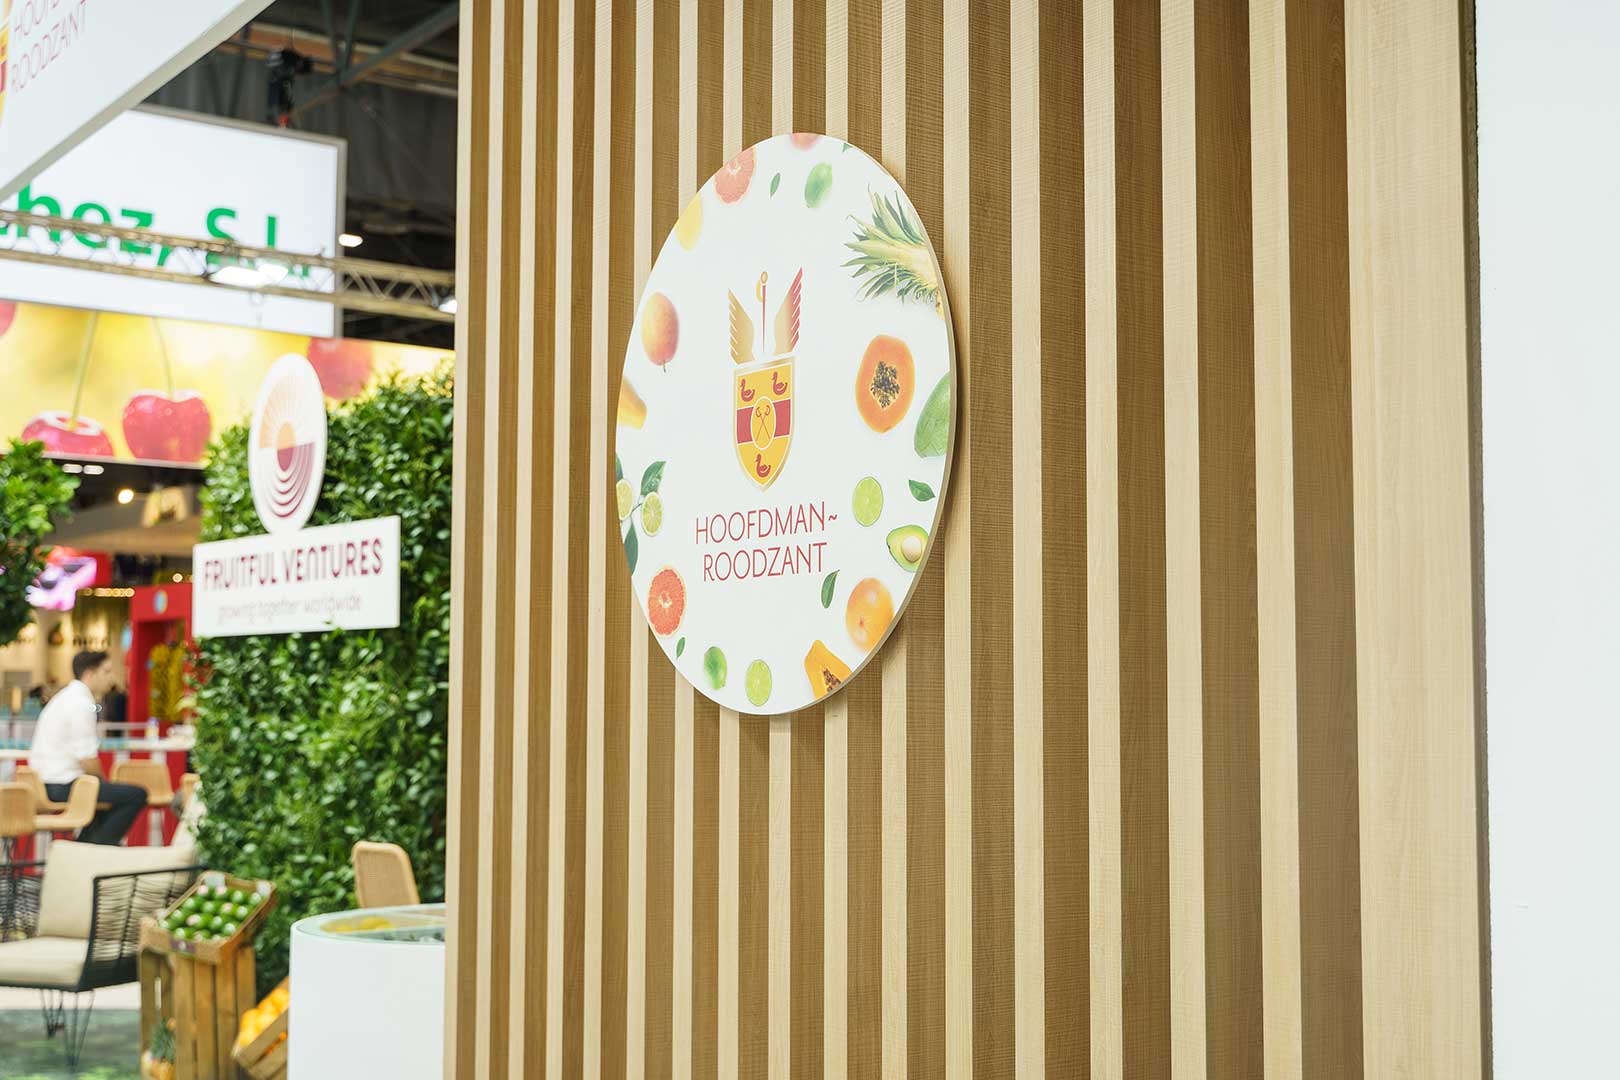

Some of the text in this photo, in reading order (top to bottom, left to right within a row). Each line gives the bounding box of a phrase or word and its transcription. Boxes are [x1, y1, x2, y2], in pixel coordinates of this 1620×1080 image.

[204, 537, 383, 590] FRUITFUL VENTURES
[703, 542, 827, 582] ROODZANT
